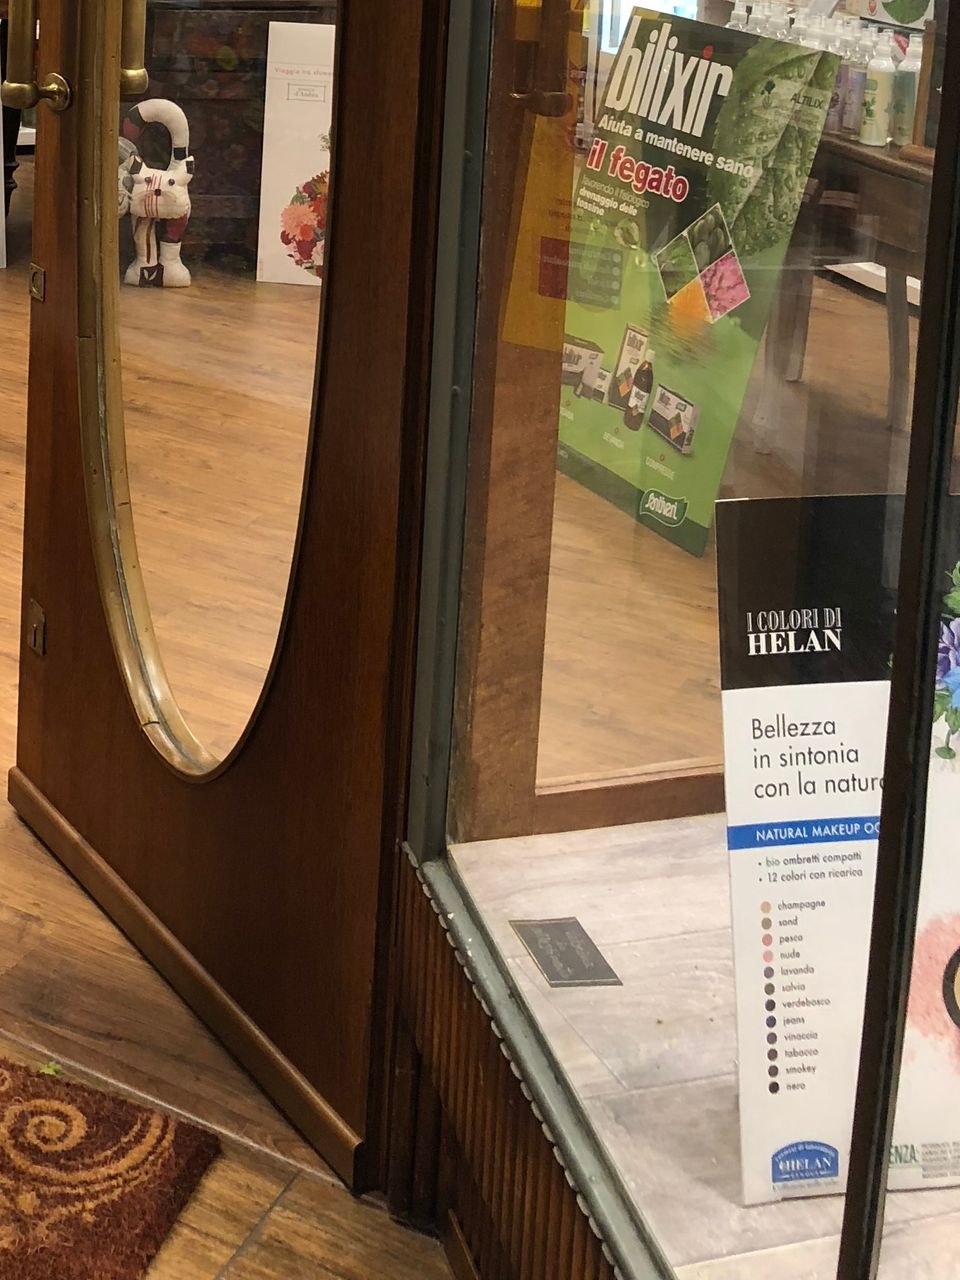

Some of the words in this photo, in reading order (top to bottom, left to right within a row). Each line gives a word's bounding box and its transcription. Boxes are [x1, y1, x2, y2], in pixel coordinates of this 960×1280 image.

[604, 15, 733, 138] bilixir
[597, 114, 633, 138] Aiuta
[635, 129, 643, 141] a
[646, 132, 714, 167] mantenere
[716, 154, 754, 179] sano
[585, 137, 608, 172] il
[608, 145, 690, 202] fegato
[747, 613, 752, 632] I
[757, 608, 818, 631] COLORI
[824, 607, 842, 627] DI
[747, 629, 842, 656] HELAN
[752, 714, 836, 740] Bellezza
[753, 748, 770, 769] in
[779, 743, 859, 766] sintonia
[754, 782, 790, 799] con
[798, 772, 817, 795] la
[756, 826, 808, 841] NATURAL
[811, 823, 860, 837] MAKEUP
[766, 856, 780, 867] bio
[783, 853, 820, 866] ombretti
[822, 850, 862, 864] compatti
[767, 872, 778, 883] 12
[781, 870, 807, 882] colori
[809, 871, 826, 880] con
[828, 867, 863, 878] ricarica
[777, 900, 826, 911] champagne
[779, 915, 798, 926] sand
[779, 935, 803, 945] pesca
[780, 949, 800, 959] nude
[781, 964, 815, 976] lavanda
[782, 982, 806, 992] salvia
[782, 997, 831, 1008] verdebosco
[783, 1017, 805, 1027] jeans
[784, 1032, 818, 1041] vinaccia
[784, 1048, 819, 1057] tabacco
[785, 1063, 816, 1074] smokey
[786, 1082, 806, 1091] nero
